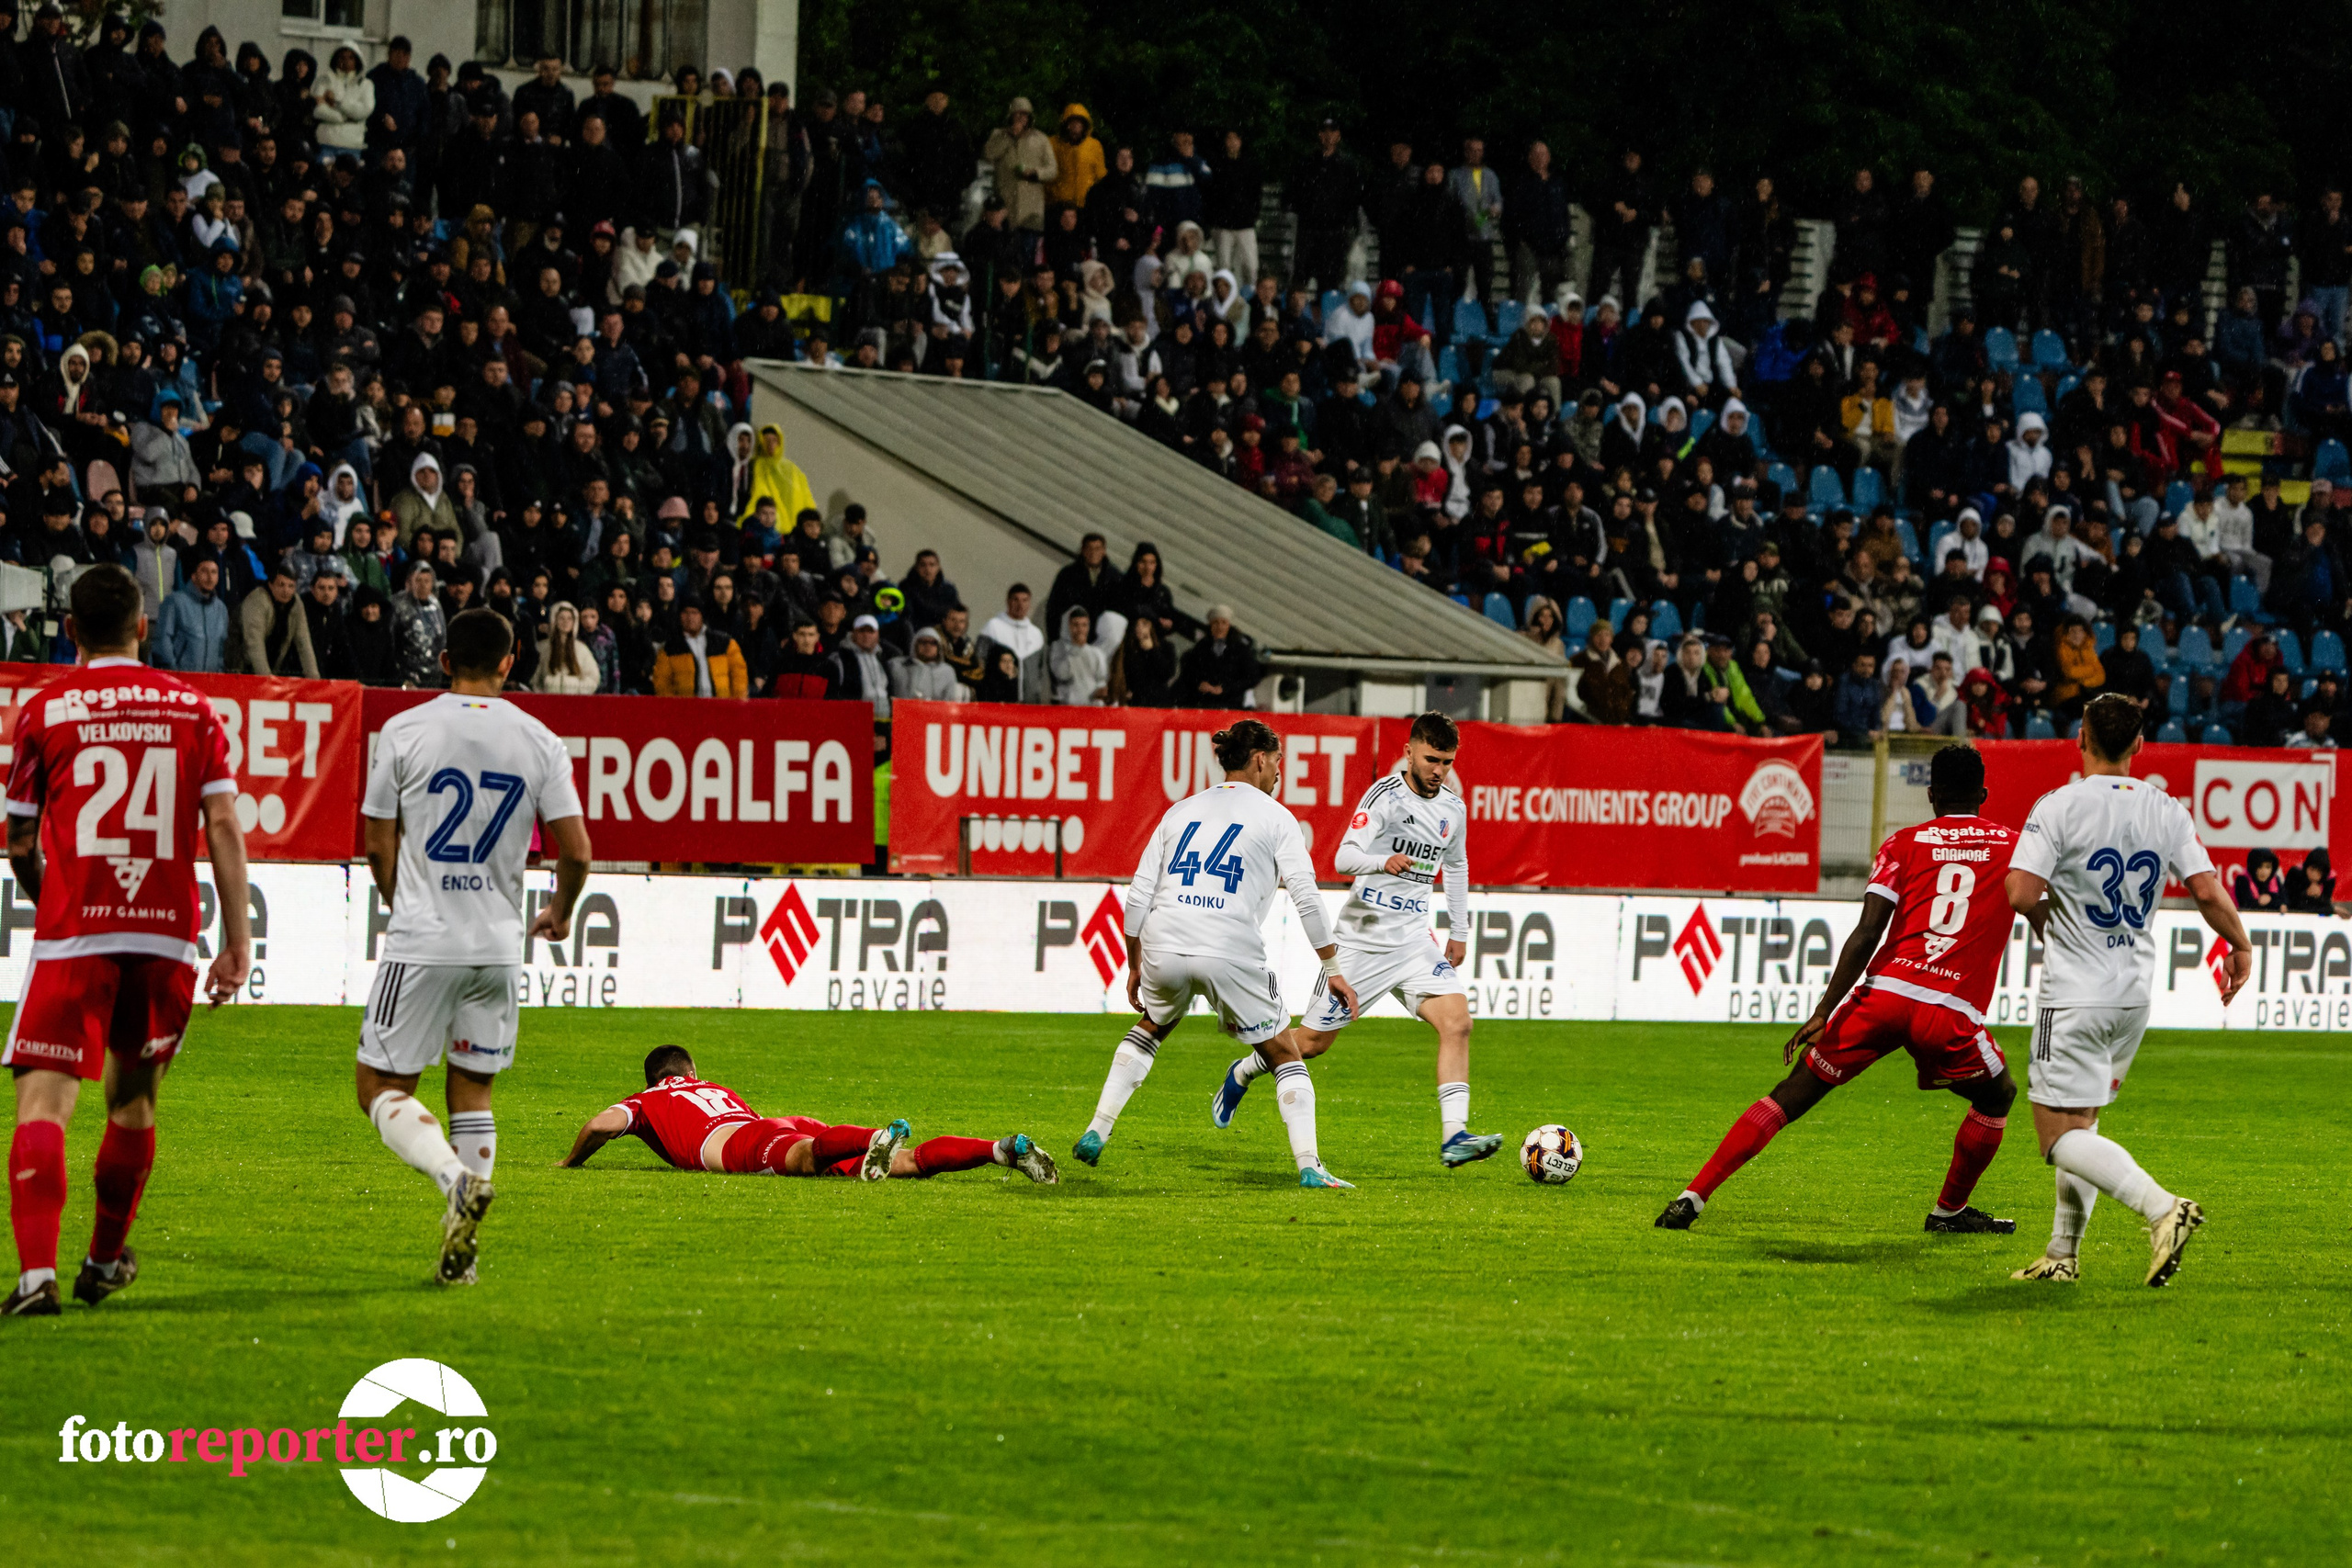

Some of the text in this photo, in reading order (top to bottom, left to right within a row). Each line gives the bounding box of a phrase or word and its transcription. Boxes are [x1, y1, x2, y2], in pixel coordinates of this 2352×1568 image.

[64, 685, 198, 709] Regata.ro
[77, 722, 172, 743] VELKOVSKI
[925, 723, 1125, 801] UNIBET
[1162, 731, 1357, 807] UNET
[74, 746, 176, 860] 24
[425, 767, 526, 863] 27
[1472, 785, 1521, 822] FIVE
[1524, 787, 1650, 826] CONTINENTS
[1654, 791, 1733, 829] GROUP
[1928, 826, 2007, 840] Regata.ro
[1168, 821, 1244, 894] 44
[1932, 847, 1990, 862] GNAHORÉ
[442, 874, 482, 891] ENZO
[2085, 847, 2161, 929] 33
[1929, 863, 1975, 935] 8
[83, 906, 176, 921] 7777 GAMING
[1914, 962, 1962, 981] GAMING
[16, 1038, 84, 1063] CARPATINA
[670, 1088, 747, 1118] 18
[1545, 1156, 1576, 1173] SELECT
